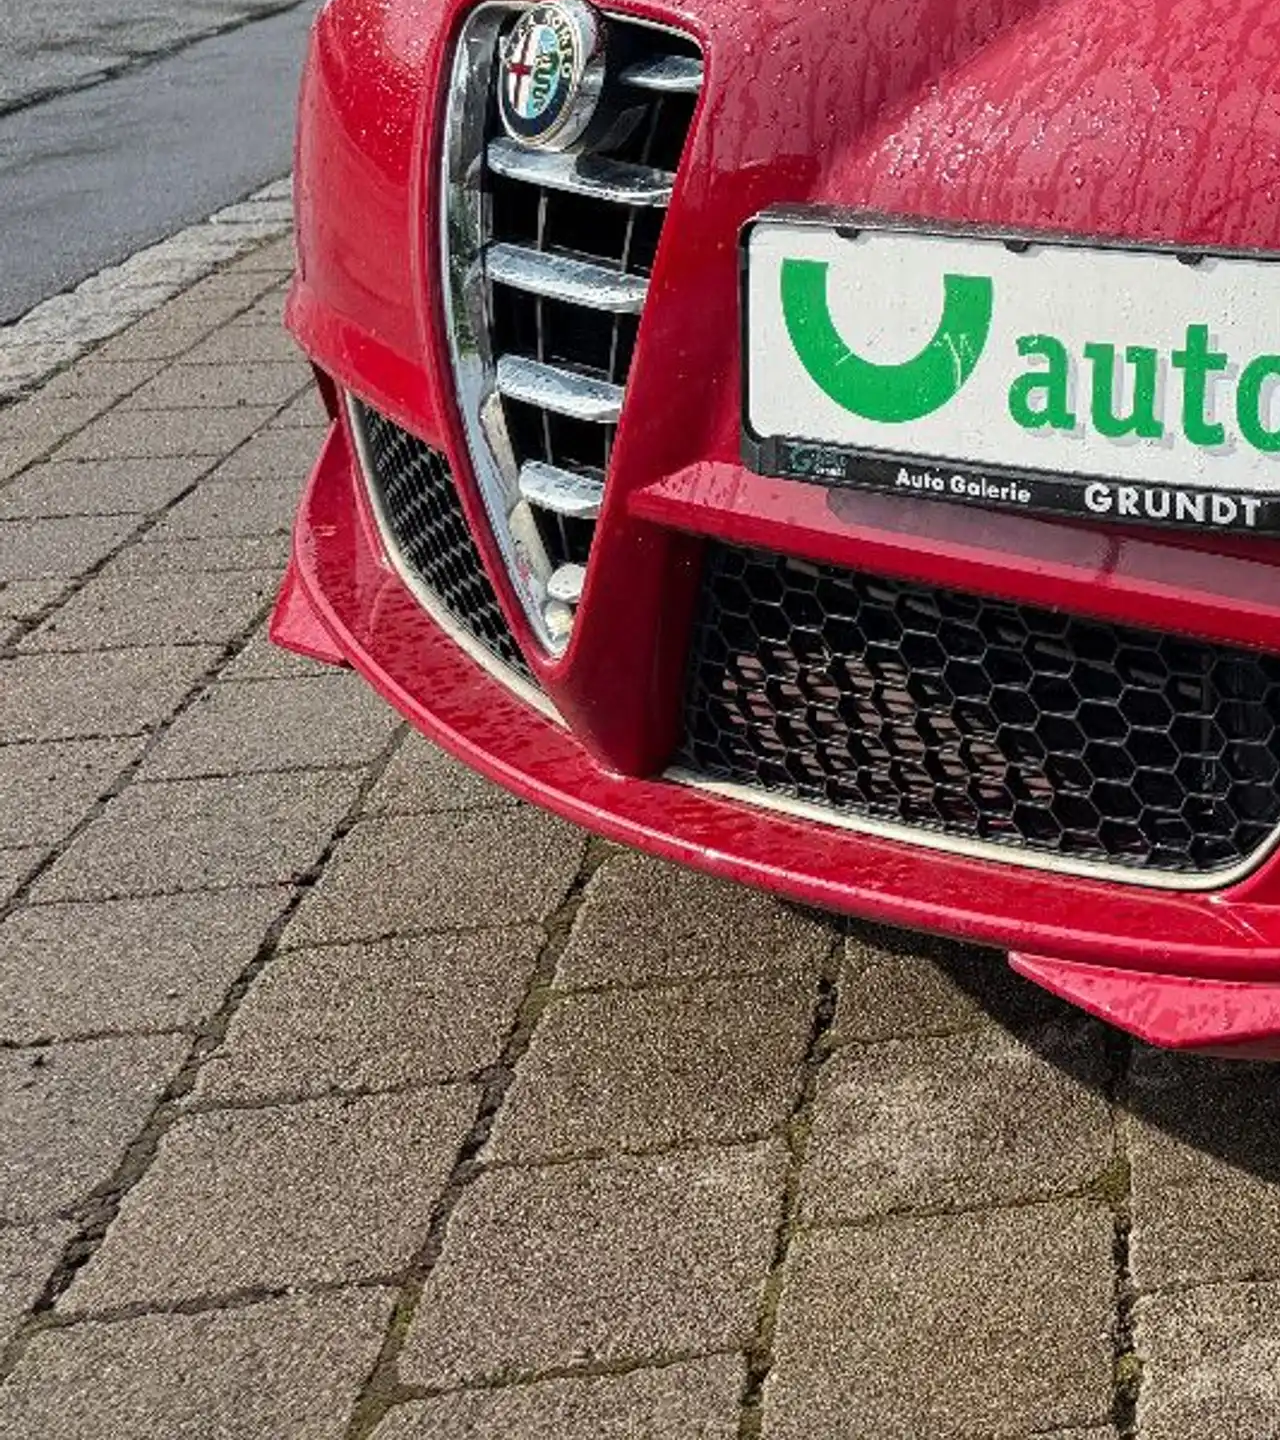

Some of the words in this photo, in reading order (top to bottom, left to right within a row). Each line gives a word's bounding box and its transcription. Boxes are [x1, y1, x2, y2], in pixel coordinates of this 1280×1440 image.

[895, 467, 944, 491] Auto
[949, 474, 1032, 503] Galerie
[1084, 482, 1271, 528] GRUNDT
